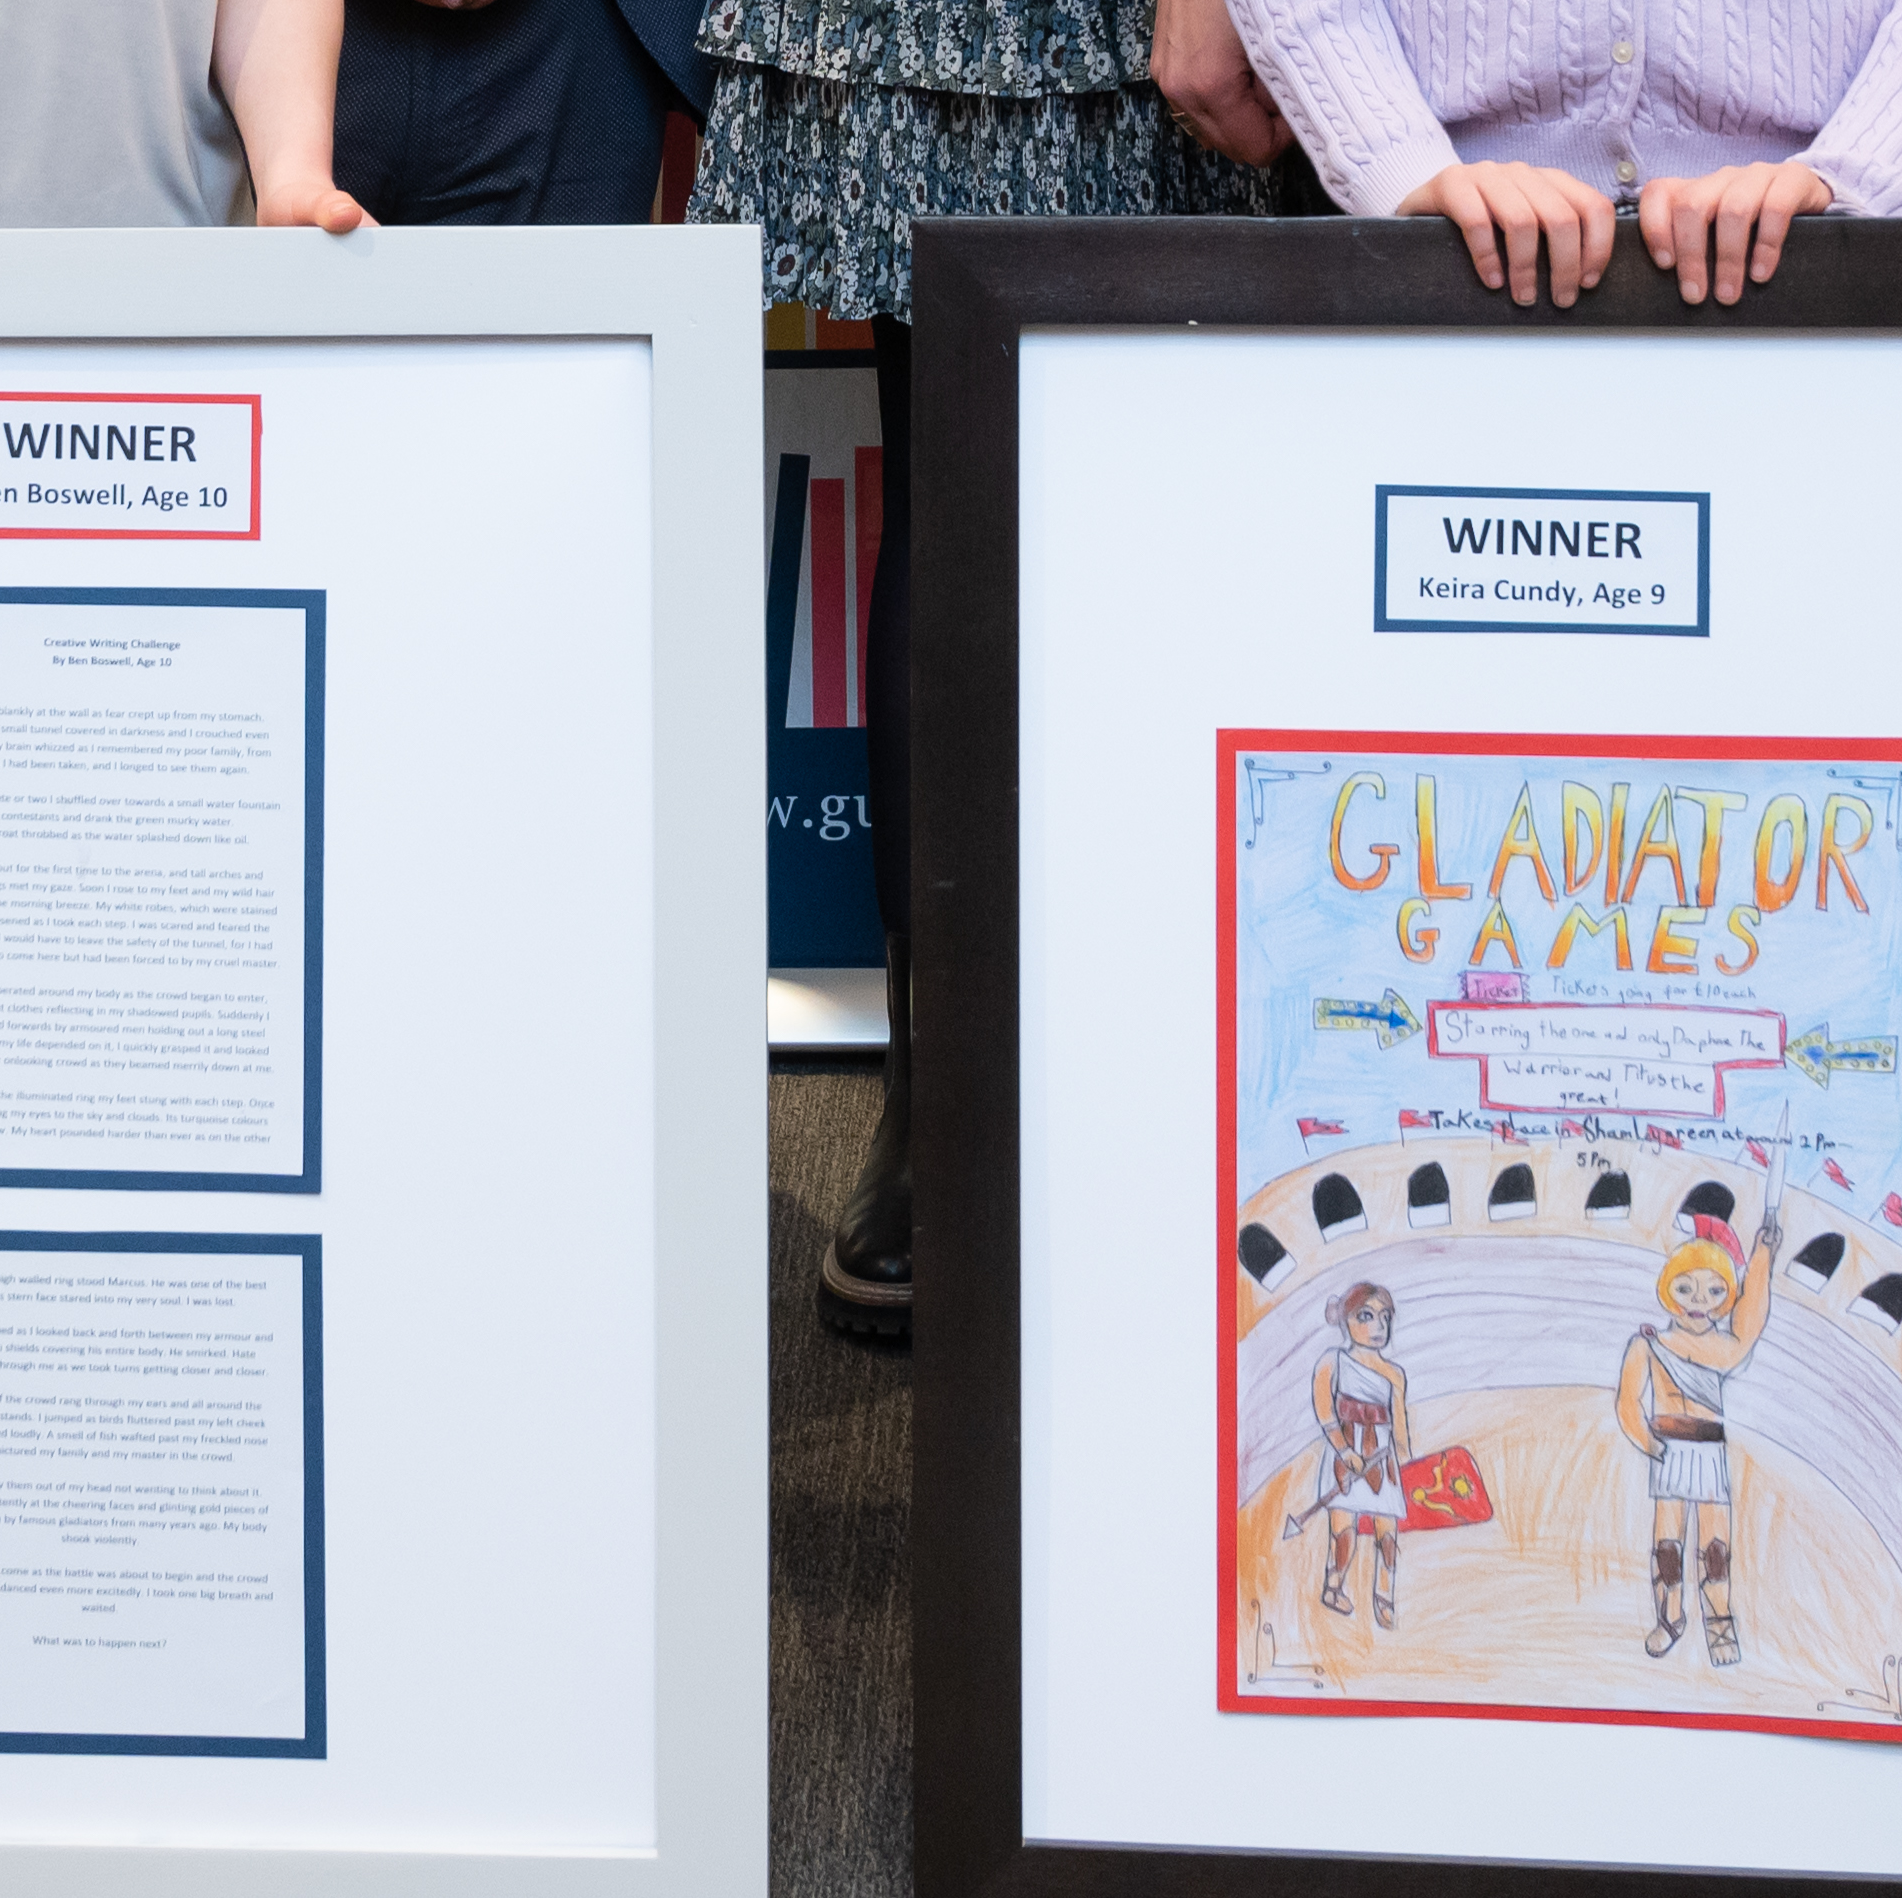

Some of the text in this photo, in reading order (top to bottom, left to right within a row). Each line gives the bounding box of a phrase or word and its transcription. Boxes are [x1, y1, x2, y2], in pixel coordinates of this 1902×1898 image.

[3, 422, 197, 463] WINNER
[27, 483, 134, 510] Boswell,
[141, 485, 190, 512] Age
[198, 487, 228, 508] 10
[1442, 517, 1643, 560] WINNER
[1418, 576, 1666, 609] Keira Cundy, Age 9
[44, 637, 181, 651] Creative Writing Challenge
[52, 655, 172, 668] By Ben Boswell, Age 10
[49, 707, 66, 717] the
[69, 707, 89, 718] wall
[105, 708, 126, 719] fear
[173, 709, 197, 721] from
[200, 712, 216, 724] my
[1329, 771, 1873, 914] GLADIATOR
[1397, 898, 1762, 974] GAMES
[1445, 1011, 1531, 1050] Starring
[33, 1635, 167, 1650] What happen next?
